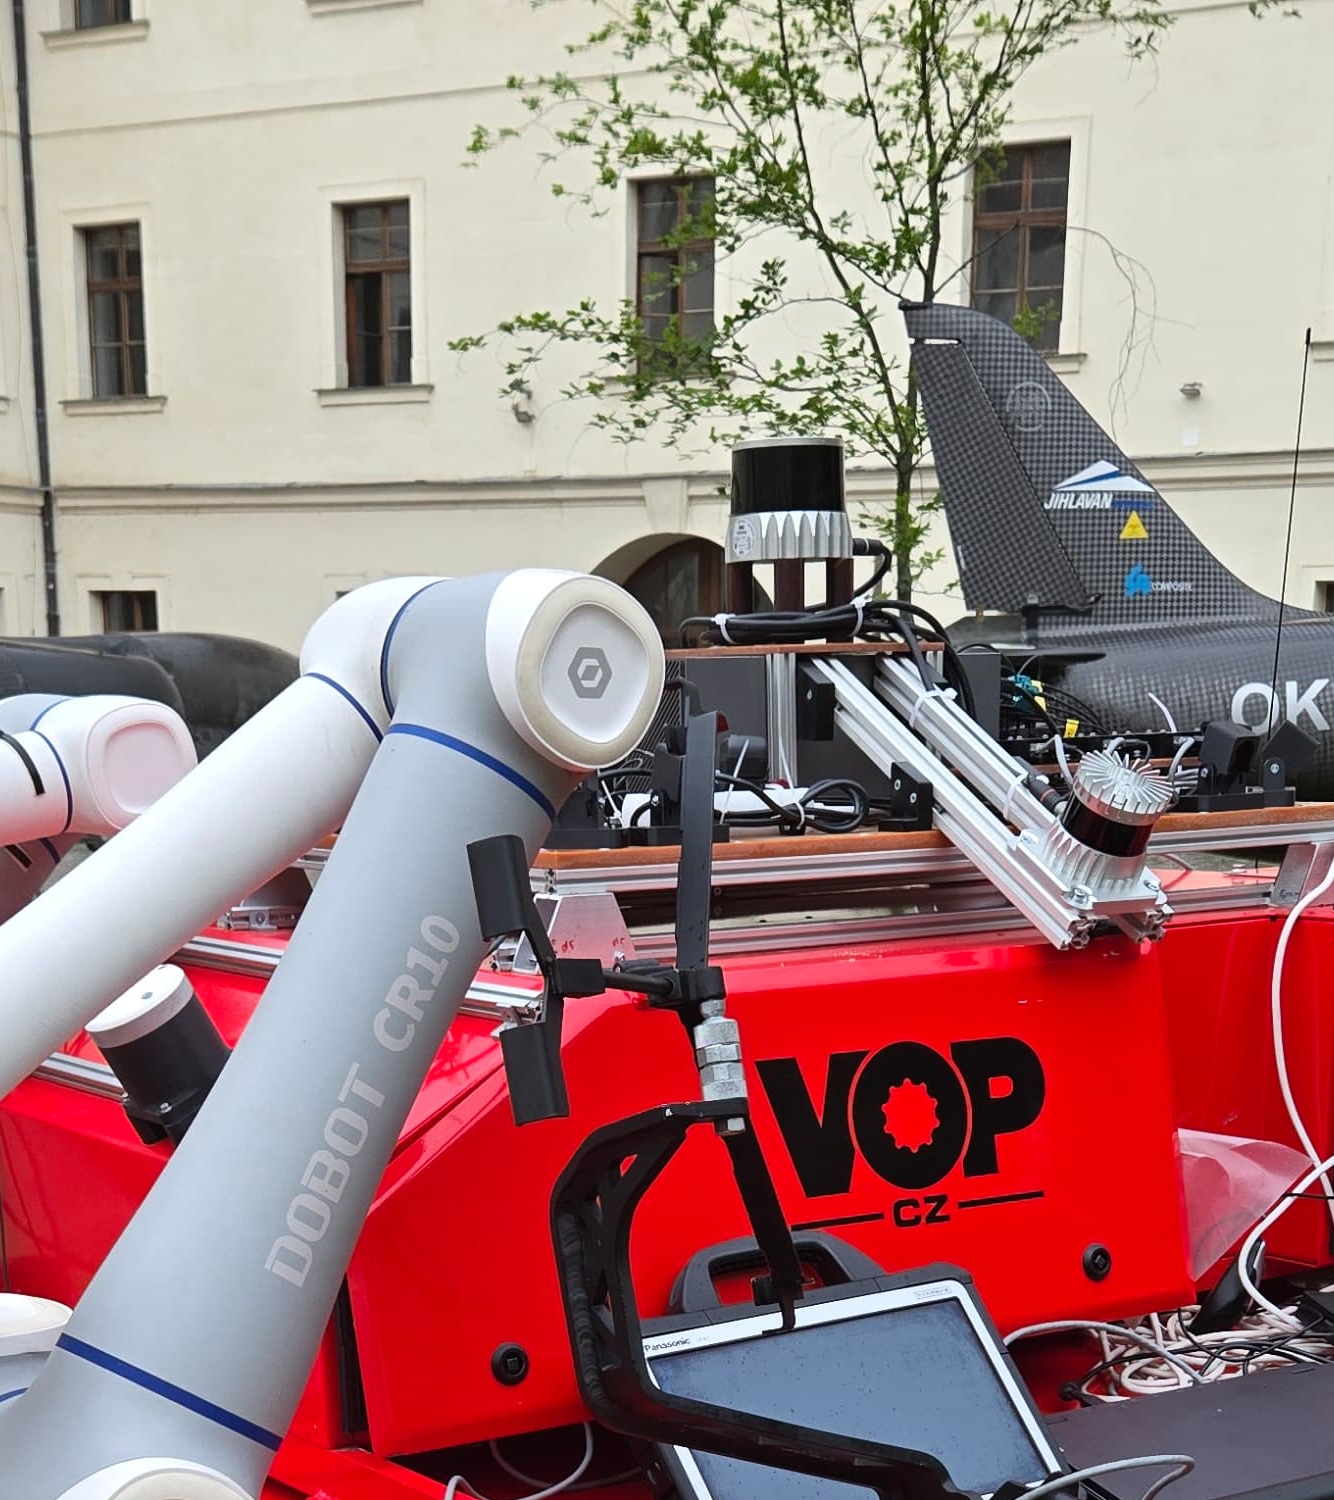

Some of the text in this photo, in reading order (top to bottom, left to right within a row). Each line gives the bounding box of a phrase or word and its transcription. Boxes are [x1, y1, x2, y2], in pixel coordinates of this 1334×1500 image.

[1043, 493, 1113, 509] JIHLAVAN
[265, 914, 460, 1288] DOBOT CR10
[755, 1037, 1046, 1198] VOP
[893, 1193, 951, 1228] CZ
[644, 1338, 691, 1353] Panasonic
